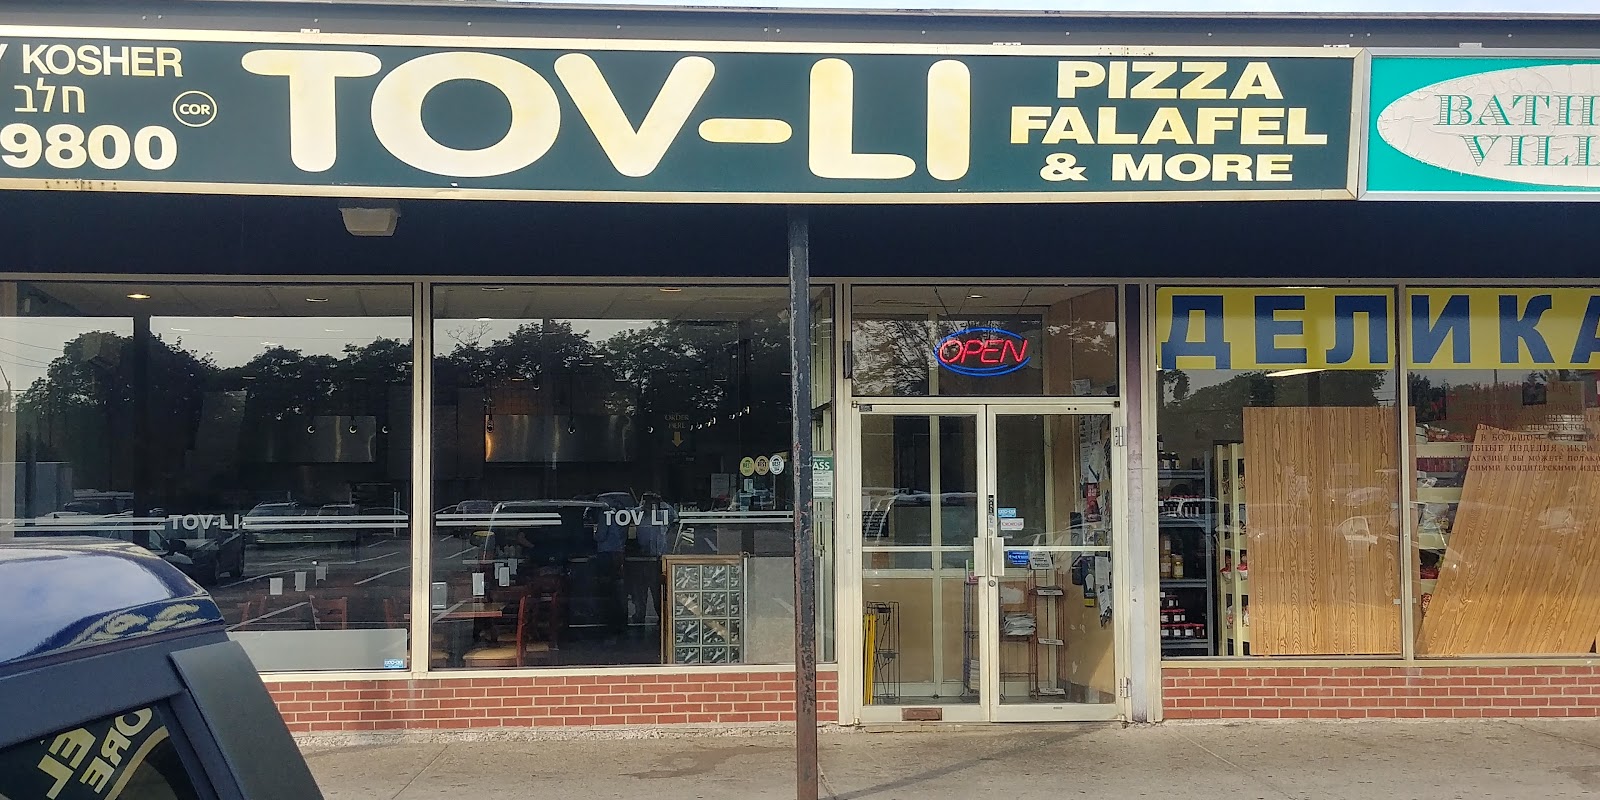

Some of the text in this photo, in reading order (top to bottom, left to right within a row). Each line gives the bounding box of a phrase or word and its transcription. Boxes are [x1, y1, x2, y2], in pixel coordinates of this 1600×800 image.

[22, 44, 183, 77] KOSHER
[14, 77, 85, 113] חלב
[1056, 61, 1284, 100] PIZZA
[179, 103, 210, 115] COR
[241, 49, 970, 181] TOV-LI
[1010, 106, 1327, 145] FALAFEL
[0, 123, 178, 170] 9800
[1039, 153, 1293, 183] & MORE
[939, 339, 1028, 363] OPEN
[813, 461, 830, 470] ASS
[168, 514, 240, 530] TOV-LI
[603, 509, 669, 526] TOV LI
